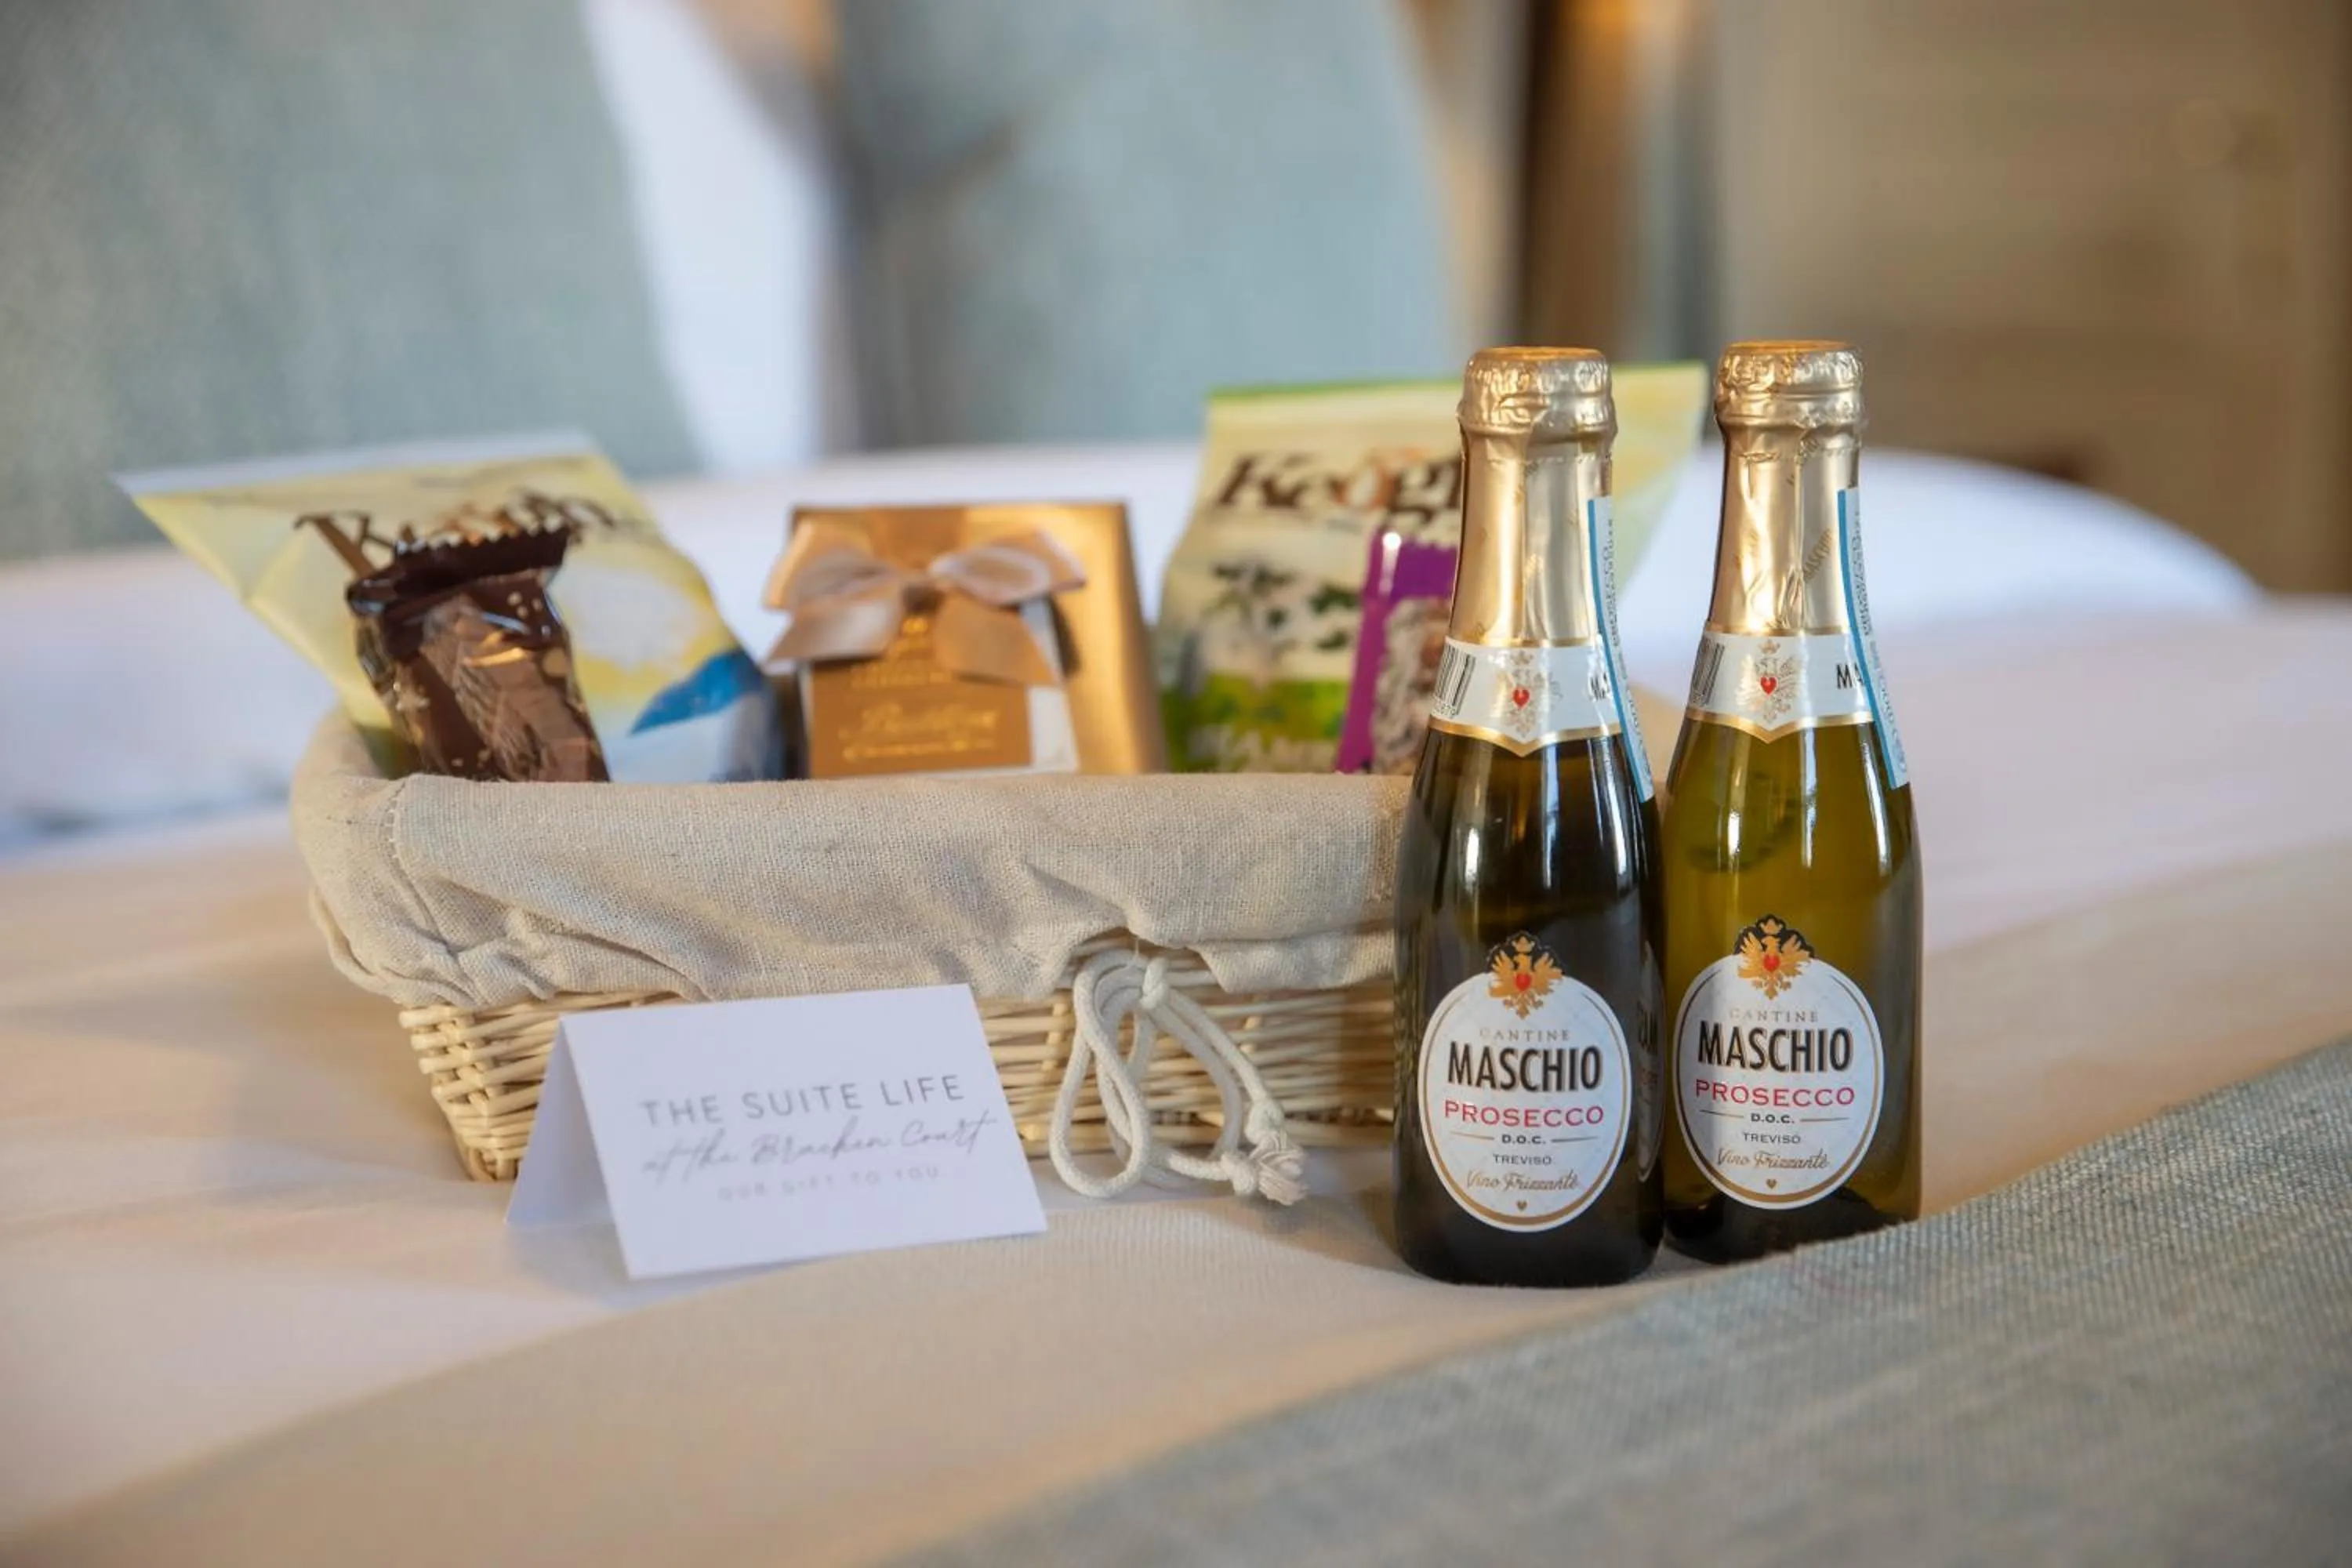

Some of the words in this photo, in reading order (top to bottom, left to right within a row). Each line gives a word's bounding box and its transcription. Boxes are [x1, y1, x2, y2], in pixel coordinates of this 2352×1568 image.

[1730, 1007, 1819, 1023] CANTINE
[1479, 1027, 1570, 1042] CANTINE
[1697, 1021, 1854, 1073] MASCHIO
[1447, 1040, 1603, 1092] MASCHIO
[639, 1094, 724, 1127] THE
[741, 1081, 864, 1120] SUITE
[880, 1073, 965, 1108] LIFE
[1695, 1078, 1855, 1108] PROSECCO
[1444, 1098, 1604, 1127] PROSECCO
[1751, 1112, 1795, 1124] D.O.C.
[900, 1108, 1000, 1156] Court
[1501, 1134, 1546, 1145] D.O.C.
[1742, 1131, 1802, 1145] TREVISO
[1493, 1152, 1552, 1166] TREVISO
[1717, 1148, 1749, 1166] Vino
[1753, 1148, 1831, 1170] Frizzante
[849, 1170, 882, 1186] TO
[893, 1164, 941, 1181] YOU
[1466, 1171, 1500, 1189] Vino
[1502, 1170, 1579, 1192] Frizzante
